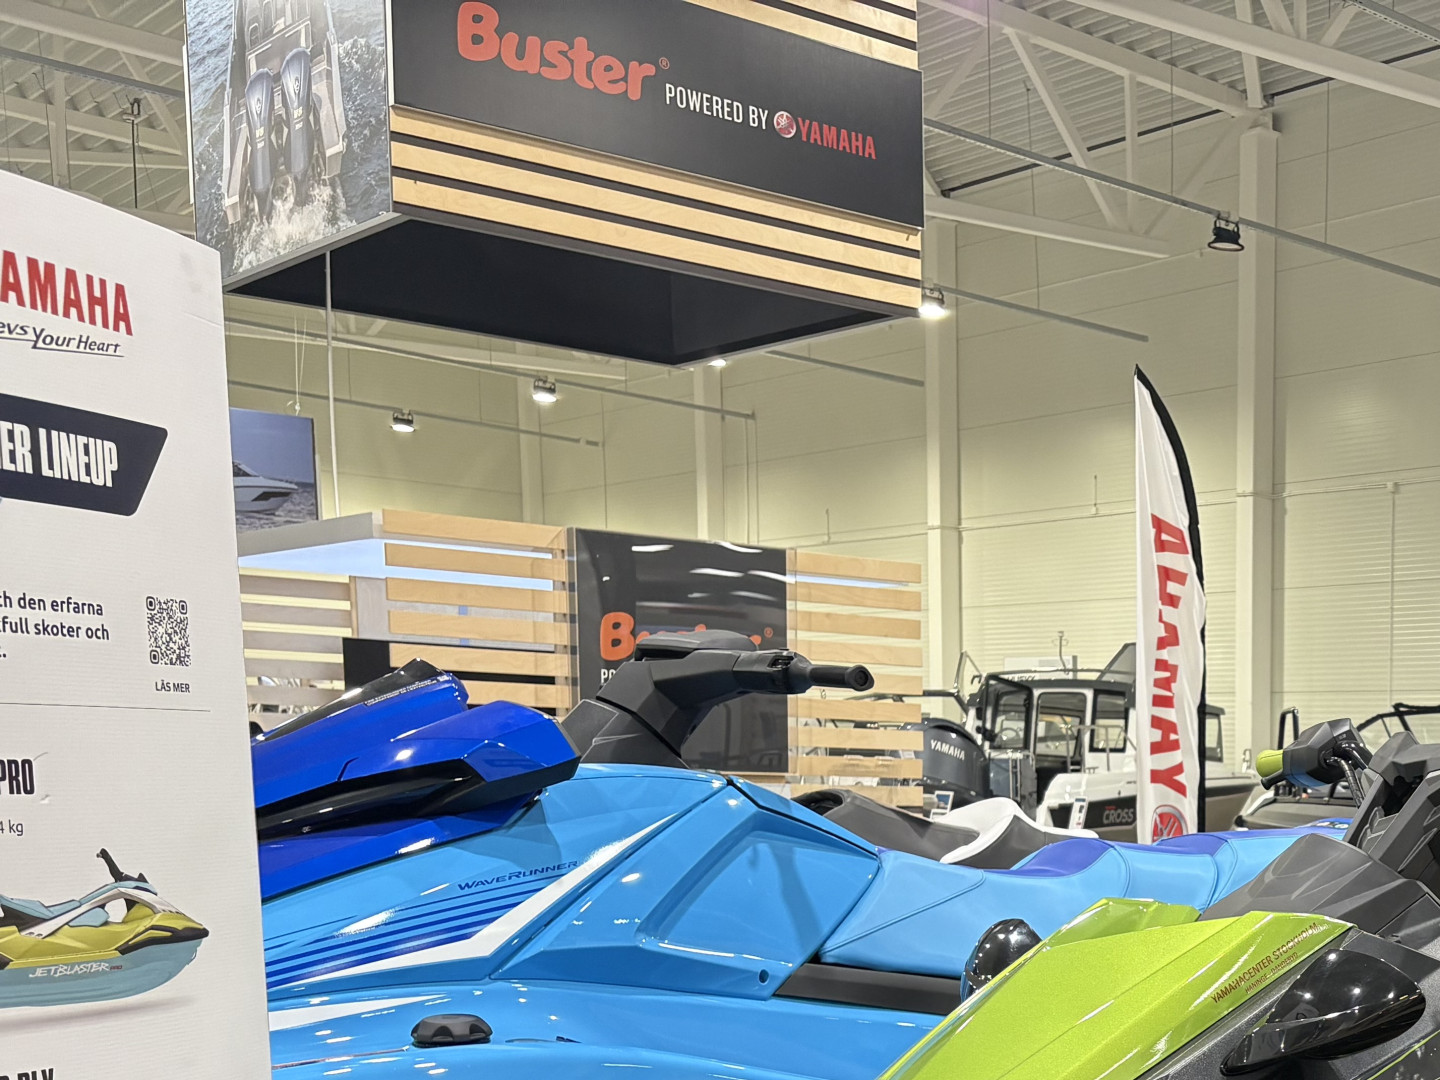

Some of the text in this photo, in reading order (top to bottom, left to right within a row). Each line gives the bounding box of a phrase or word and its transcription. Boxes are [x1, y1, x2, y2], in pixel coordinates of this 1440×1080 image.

[456, 2, 656, 100] Buster
[665, 83, 877, 159] POWERED BY YAMAHA
[31, 326, 76, 350] Your
[77, 335, 121, 354] Heart
[0, 420, 119, 488] ER LINEUP
[17, 592, 47, 611] den
[50, 597, 104, 616] erfarna
[0, 615, 110, 641] full skoter och
[1150, 512, 1190, 799] YAMAHA
[155, 679, 191, 693] LÄS MER
[930, 738, 966, 761] YAMAHA
[9, 819, 24, 837] kg
[1103, 808, 1134, 825] CROSS
[29, 962, 110, 978] JETBLASTER
[1211, 954, 1274, 1004] YAMAHACENTER
